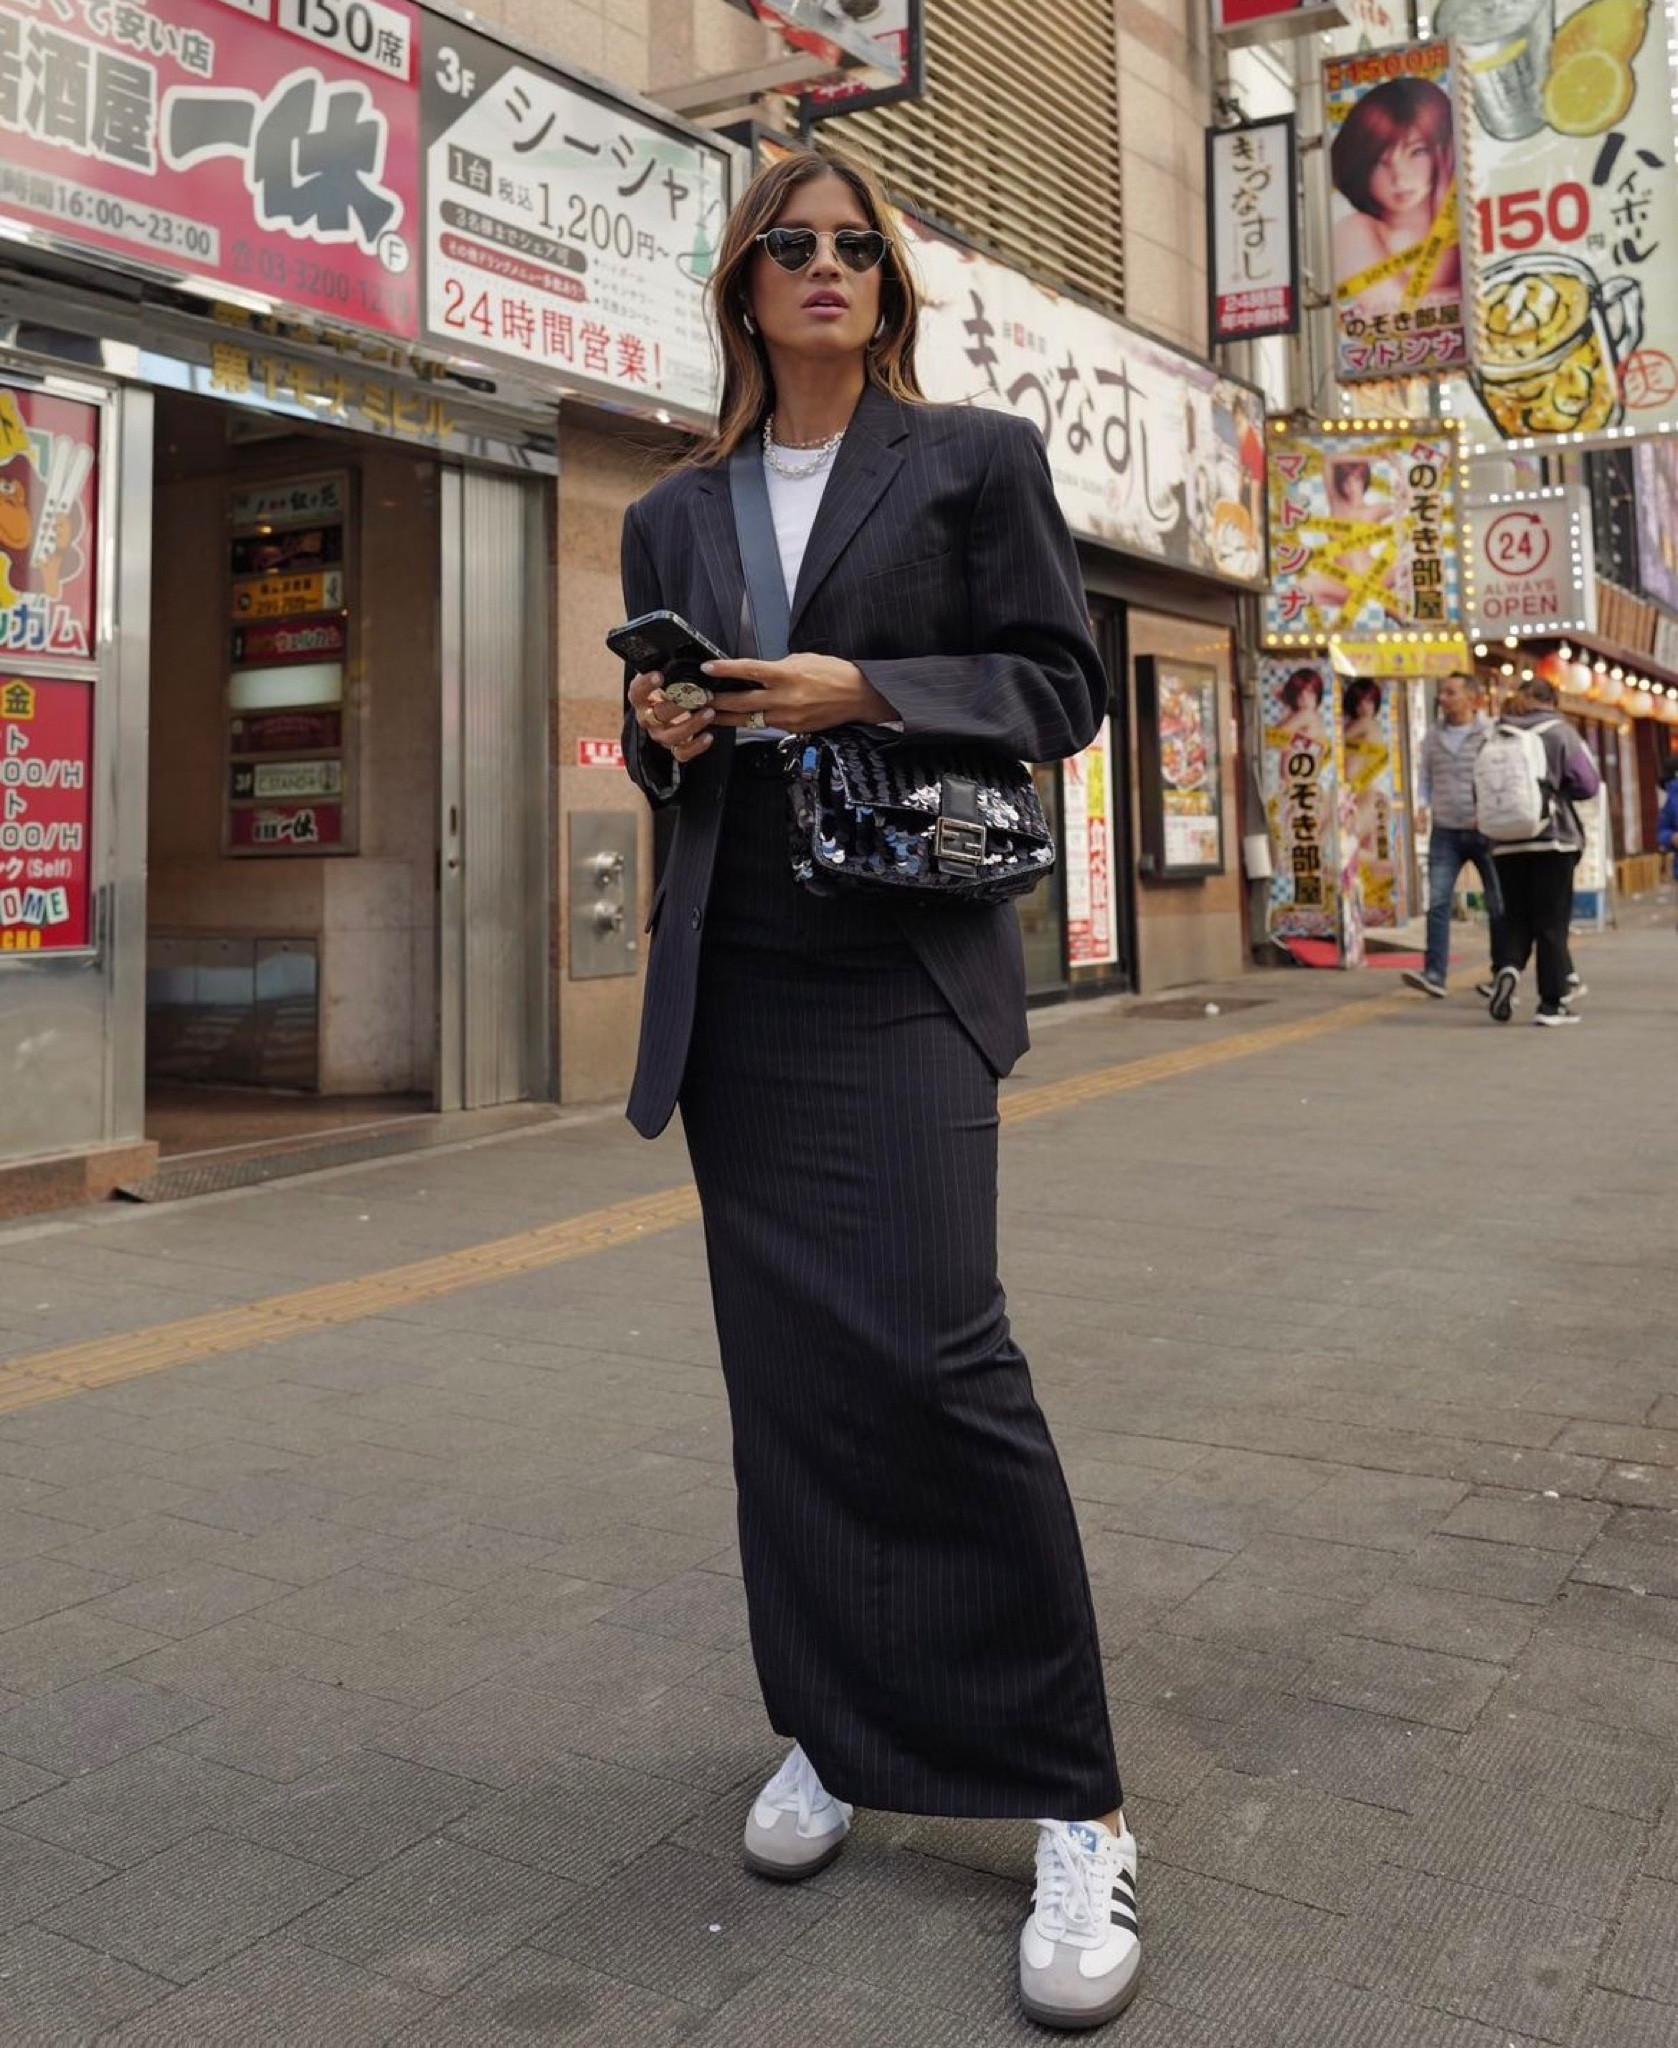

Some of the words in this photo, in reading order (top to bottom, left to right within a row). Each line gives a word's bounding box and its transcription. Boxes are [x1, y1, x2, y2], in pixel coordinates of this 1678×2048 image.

[436, 47, 476, 98] 3F
[503, 85, 690, 222] シーシャ
[450, 150, 491, 194] 1台
[1500, 531, 1533, 560] 24
[1484, 577, 1556, 596] ALWAYS
[1484, 596, 1559, 619] OPEN
